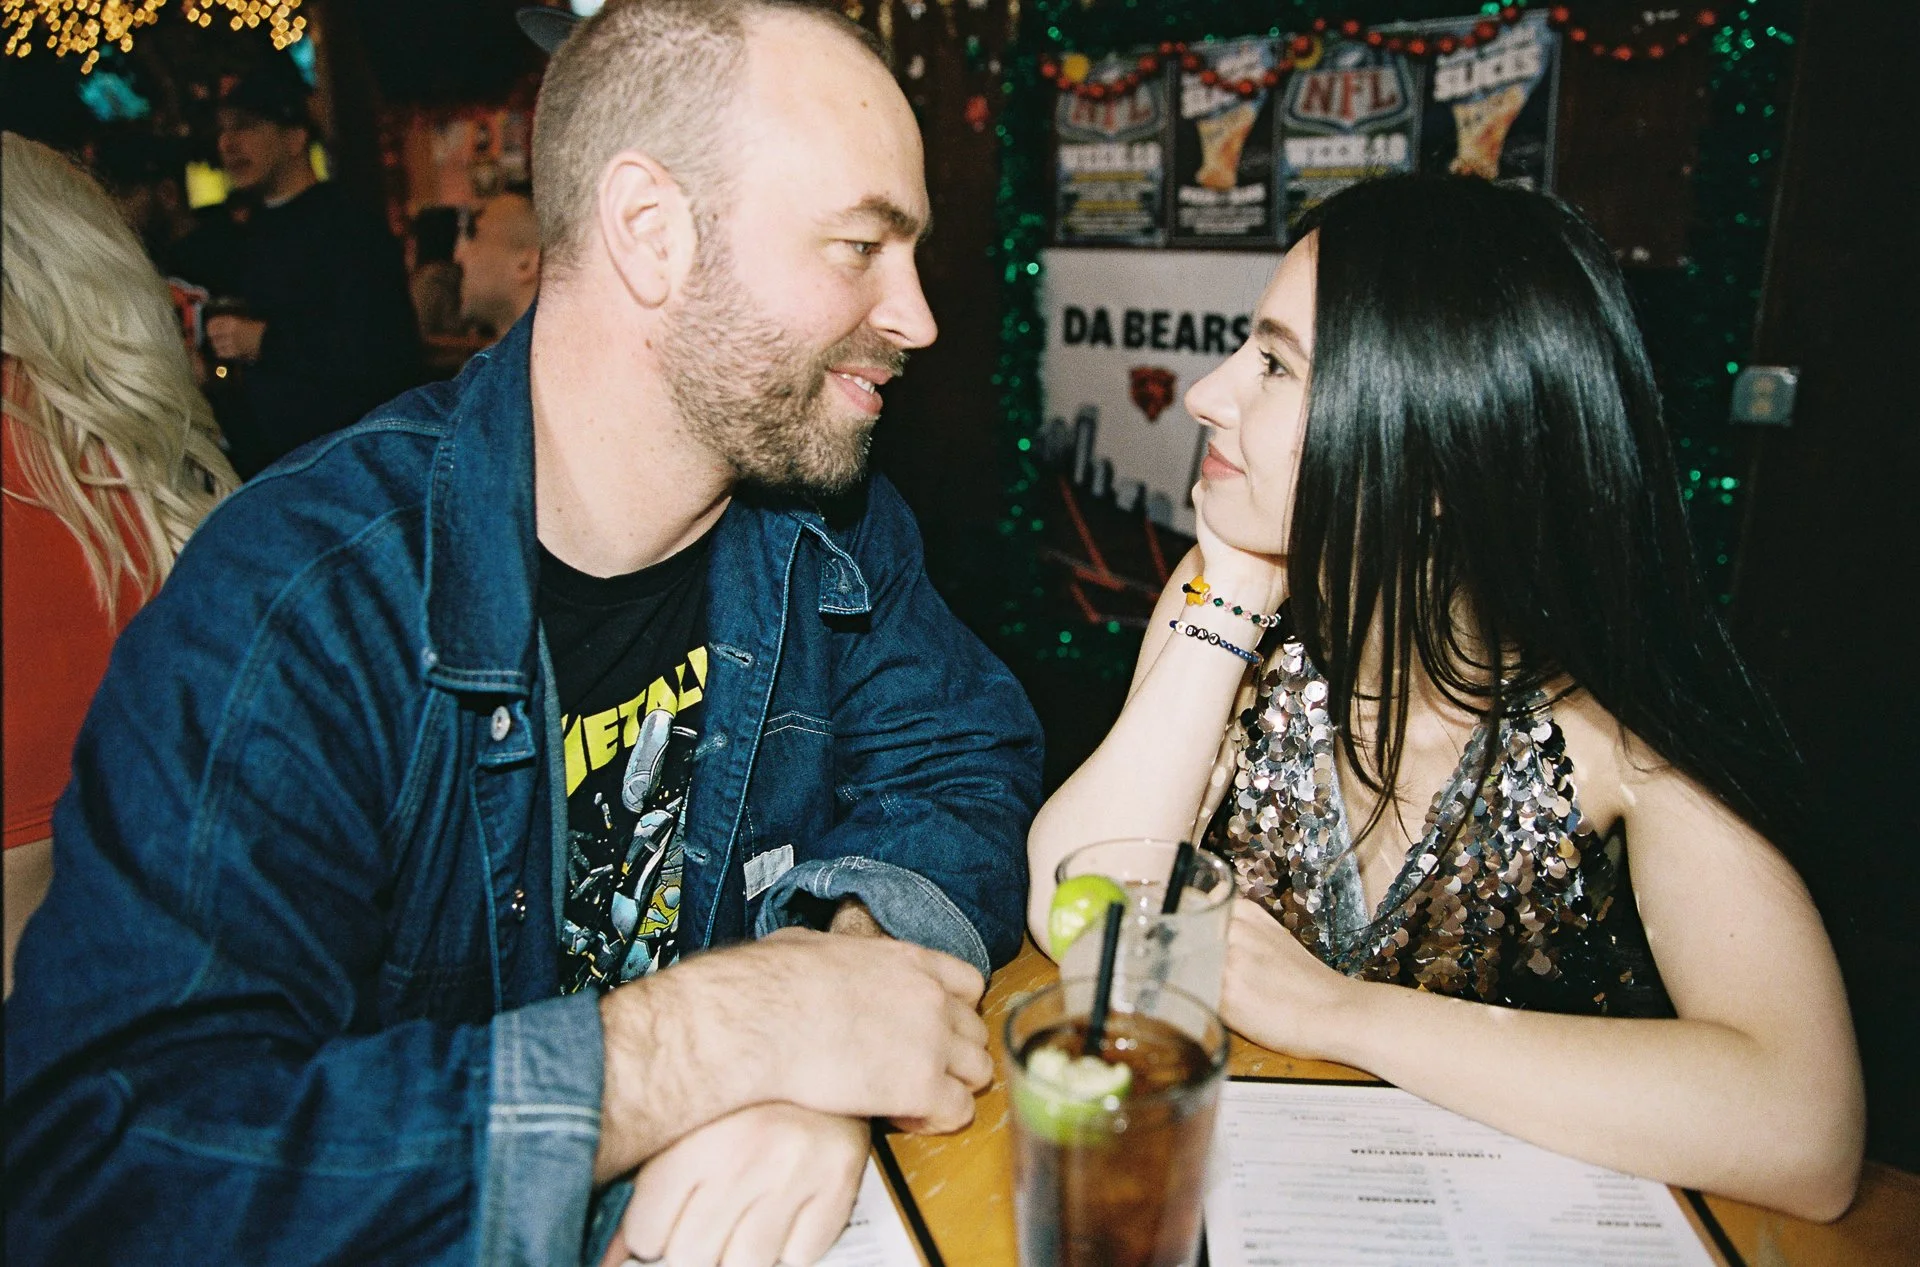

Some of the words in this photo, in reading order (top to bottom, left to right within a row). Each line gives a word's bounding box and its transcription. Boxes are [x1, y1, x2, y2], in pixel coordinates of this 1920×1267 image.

[1302, 71, 1397, 121] NFL
[1063, 305, 1113, 347] DA
[1123, 308, 1250, 354] BEARS
